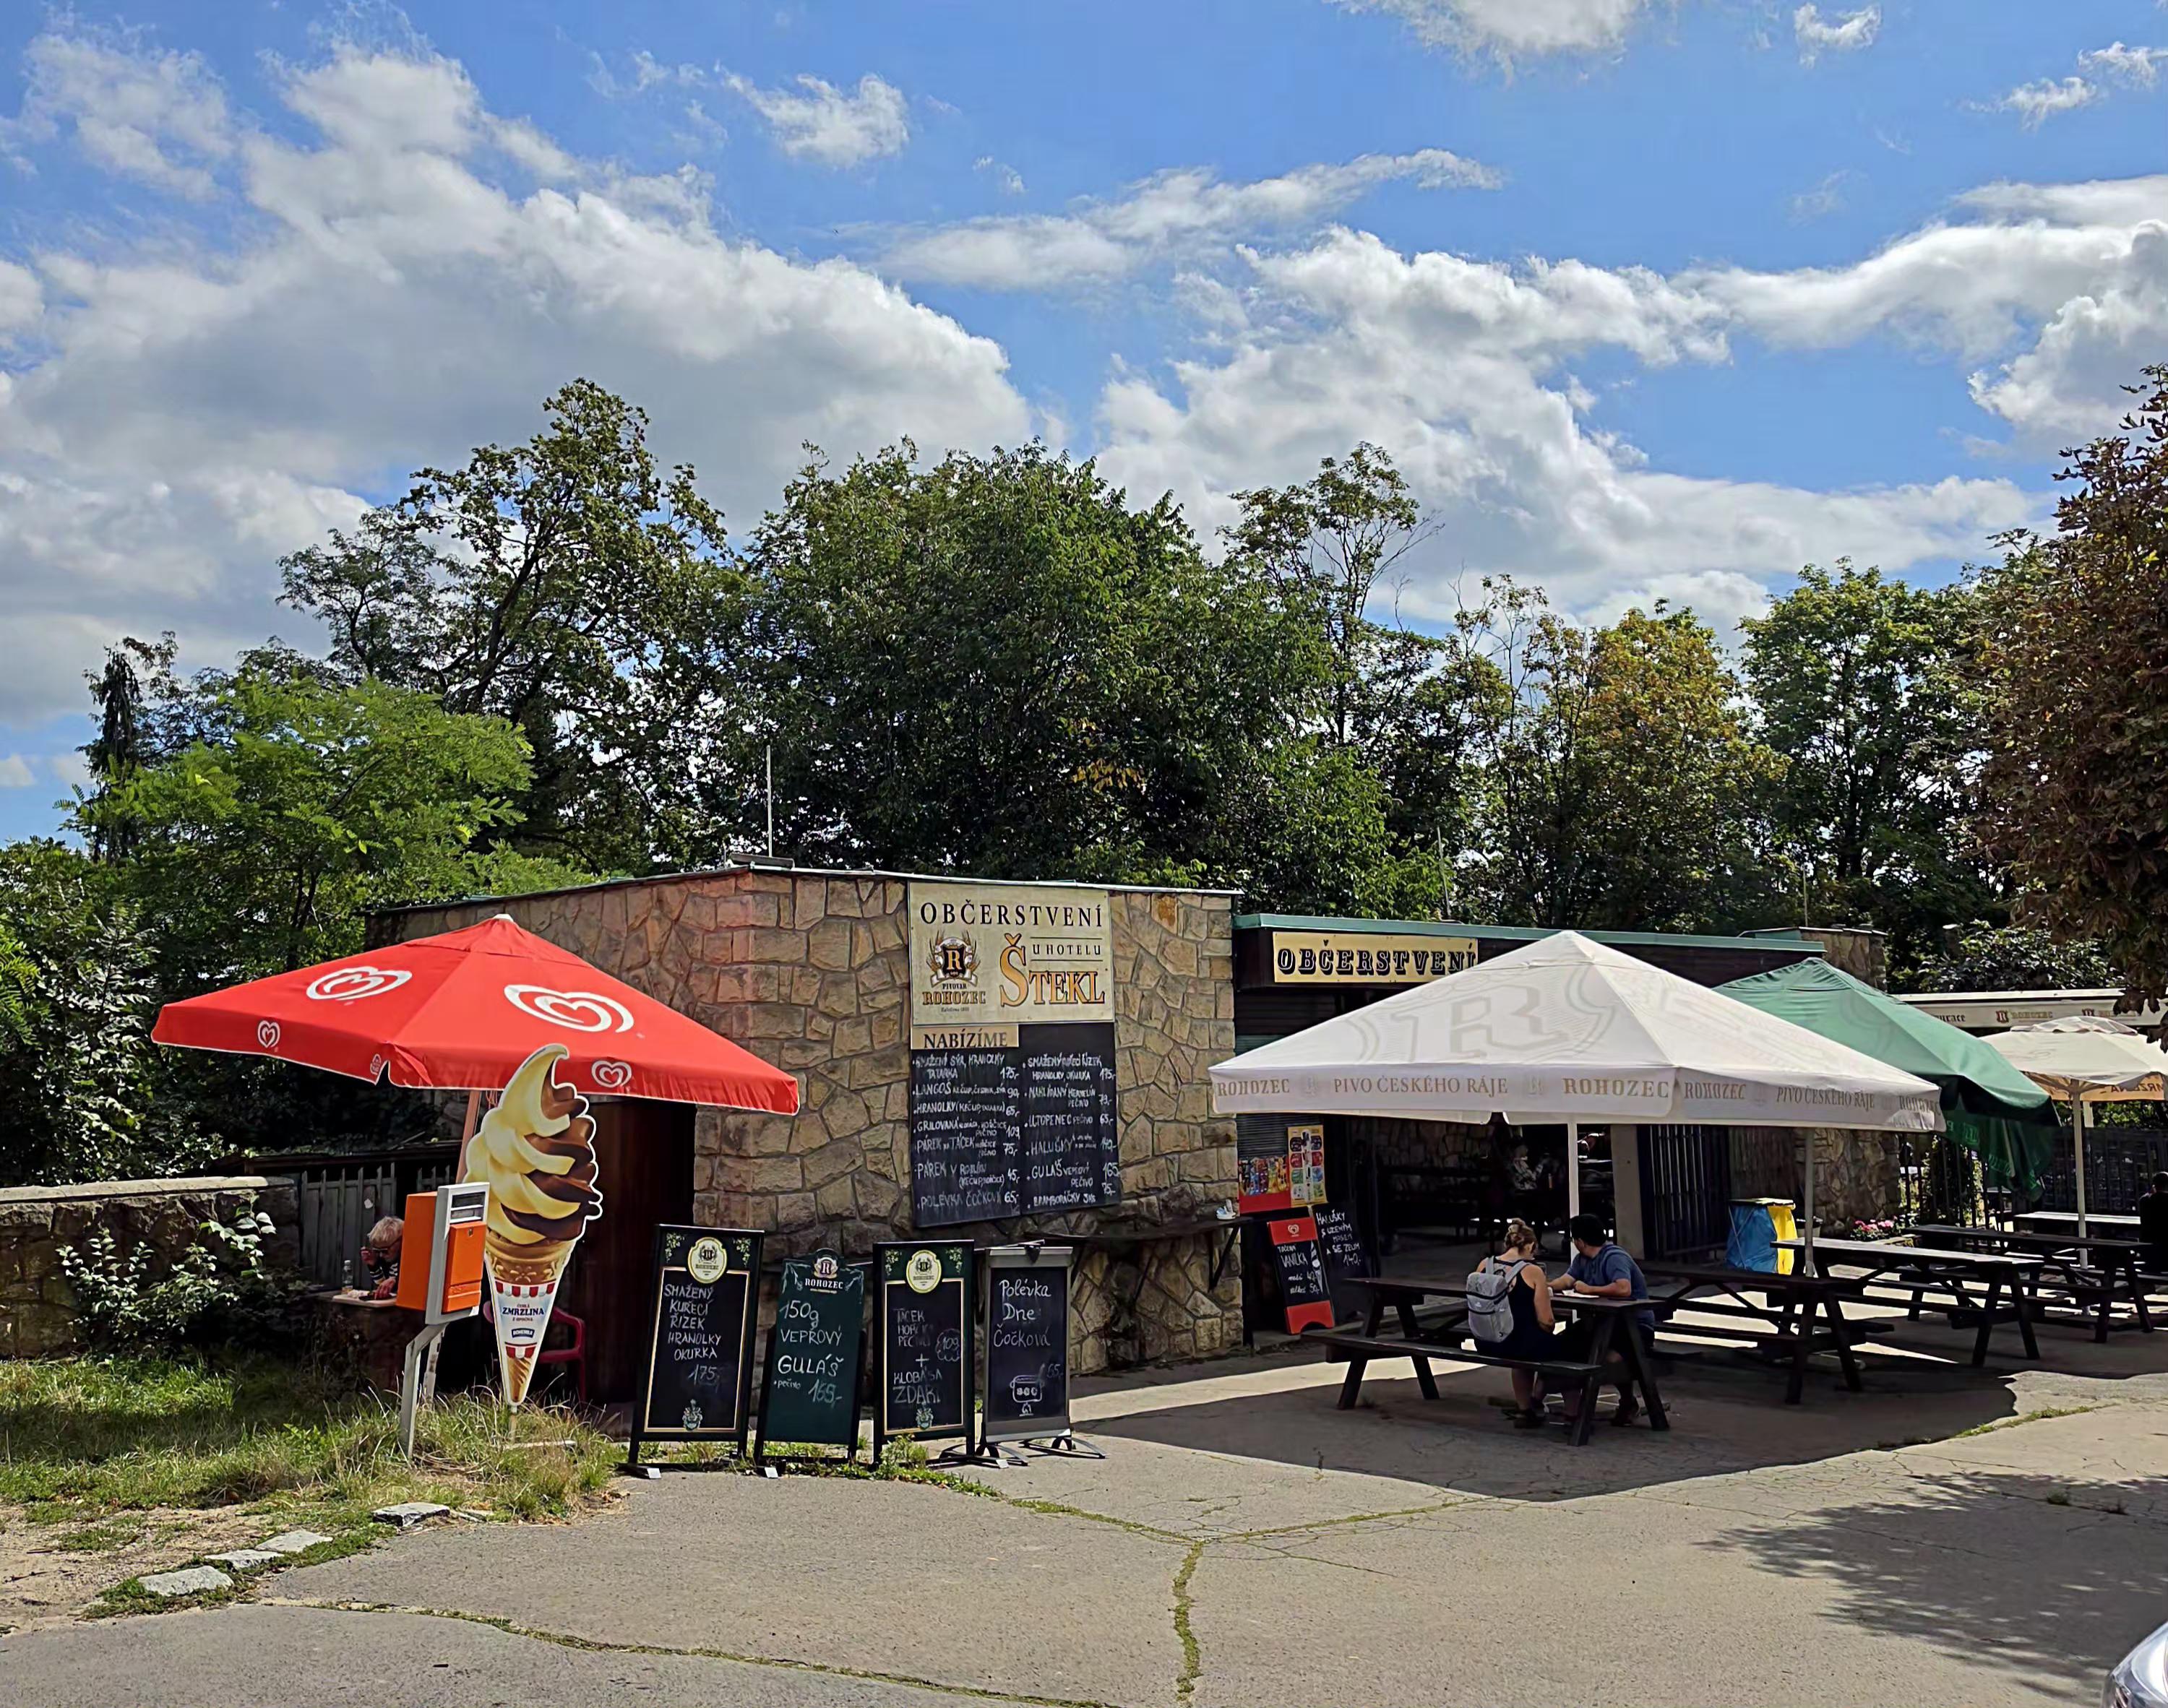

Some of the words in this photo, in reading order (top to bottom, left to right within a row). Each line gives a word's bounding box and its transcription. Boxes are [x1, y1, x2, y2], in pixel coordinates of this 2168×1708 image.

[920, 900, 1102, 927] OBČERSTVENÍ
[947, 949, 961, 970] R
[1033, 944, 1041, 955] U
[1046, 944, 1101, 955] HOTELU
[1277, 939, 1476, 975] OBČERSTVENÍ
[999, 933, 1105, 1007] ŠTEKL
[922, 991, 986, 1006] ROHOZEC
[924, 1027, 1007, 1048] NABÍZÍME
[1218, 1079, 1290, 1097] ROHOZEC
[1334, 1077, 1372, 1093] PIVO
[1377, 1074, 1461, 1094] ČESKÉHO
[1467, 1075, 1508, 1098] RÁJE
[1562, 1078, 1669, 1099] ROHOZEC
[1684, 1082, 1746, 1100] ROHOZEC
[1776, 1085, 1803, 1104] PIVO
[1854, 1090, 1875, 1110] RÁJE
[805, 1277, 844, 1290] ROHOZEC
[999, 1278, 1051, 1298] Polévka
[502, 1307, 544, 1316] ZMRZLINA
[779, 1300, 820, 1329] 150g
[1002, 1303, 1036, 1321] Dne
[668, 1332, 721, 1346] HRANOLKY
[780, 1324, 843, 1347] VEPŘOVÝ
[994, 1323, 1051, 1348] Čočková
[674, 1346, 718, 1361] OKURKA
[778, 1354, 844, 1378] GULÁŠ
